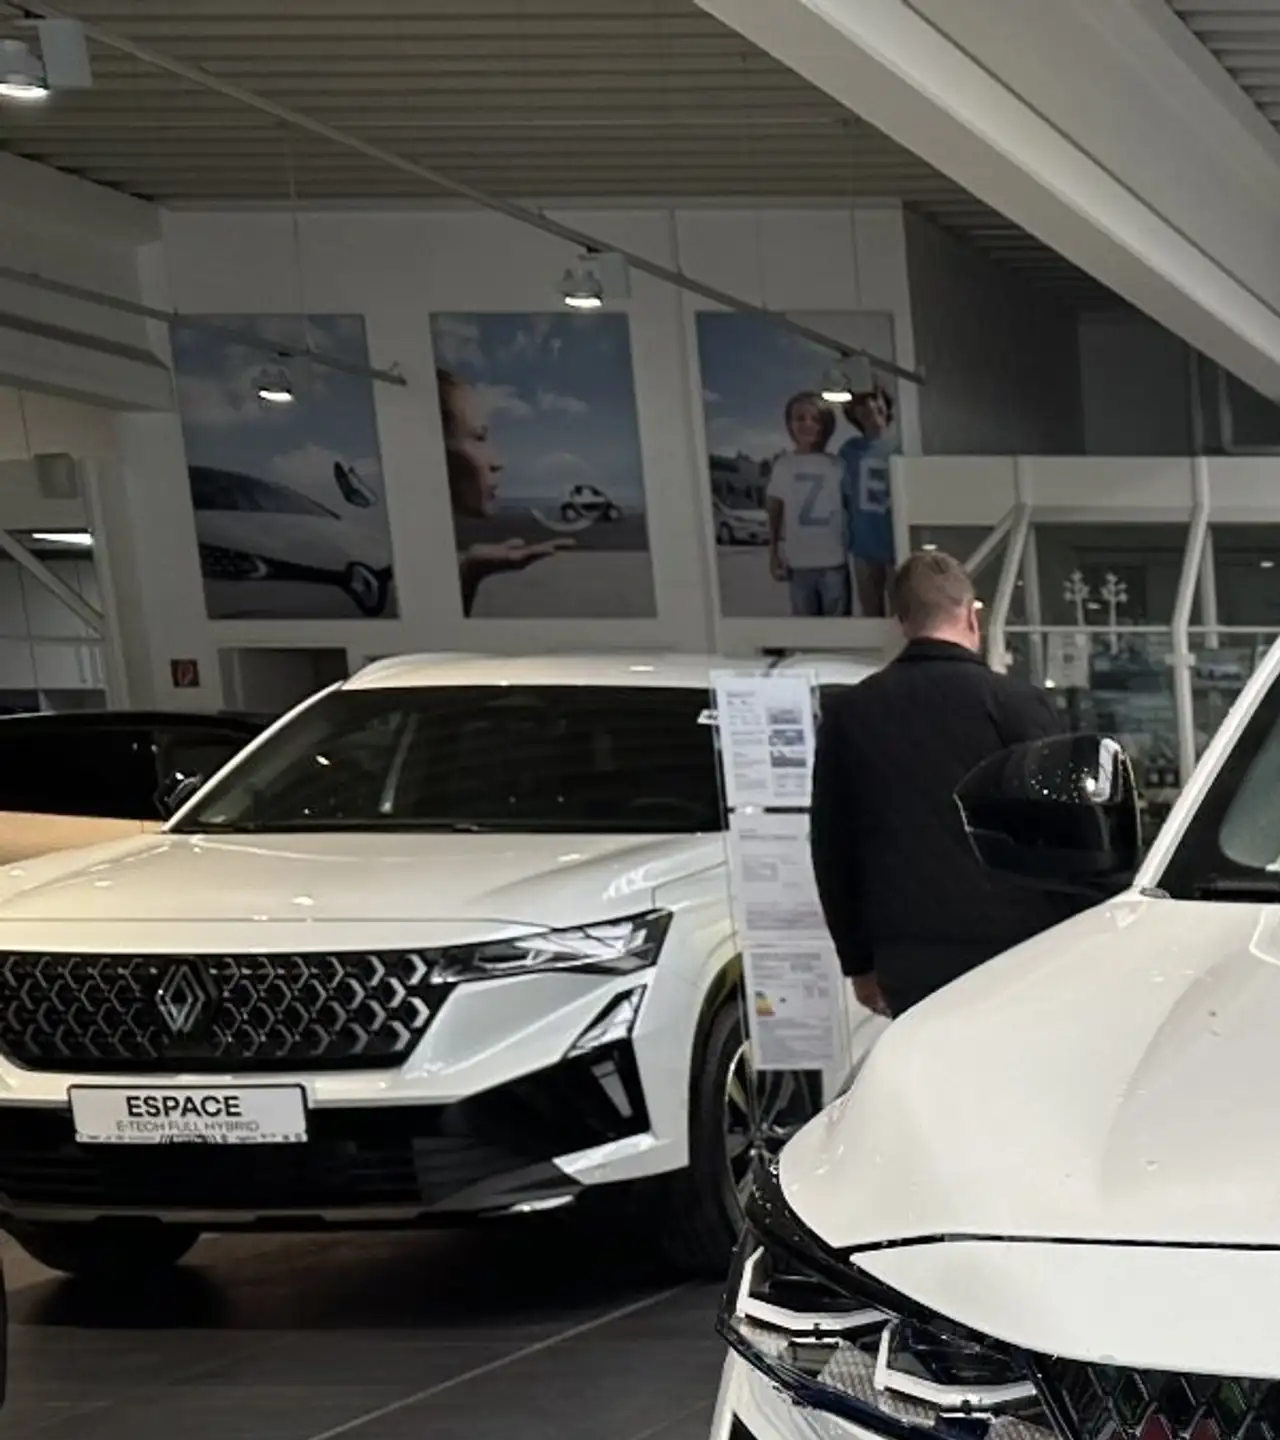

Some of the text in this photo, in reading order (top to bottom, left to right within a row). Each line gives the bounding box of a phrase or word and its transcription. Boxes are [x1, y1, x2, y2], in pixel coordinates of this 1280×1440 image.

[794, 472, 831, 526] Z
[125, 1095, 243, 1118] ESPACE
[116, 1119, 260, 1133] E-TECH FULL HYBRID
